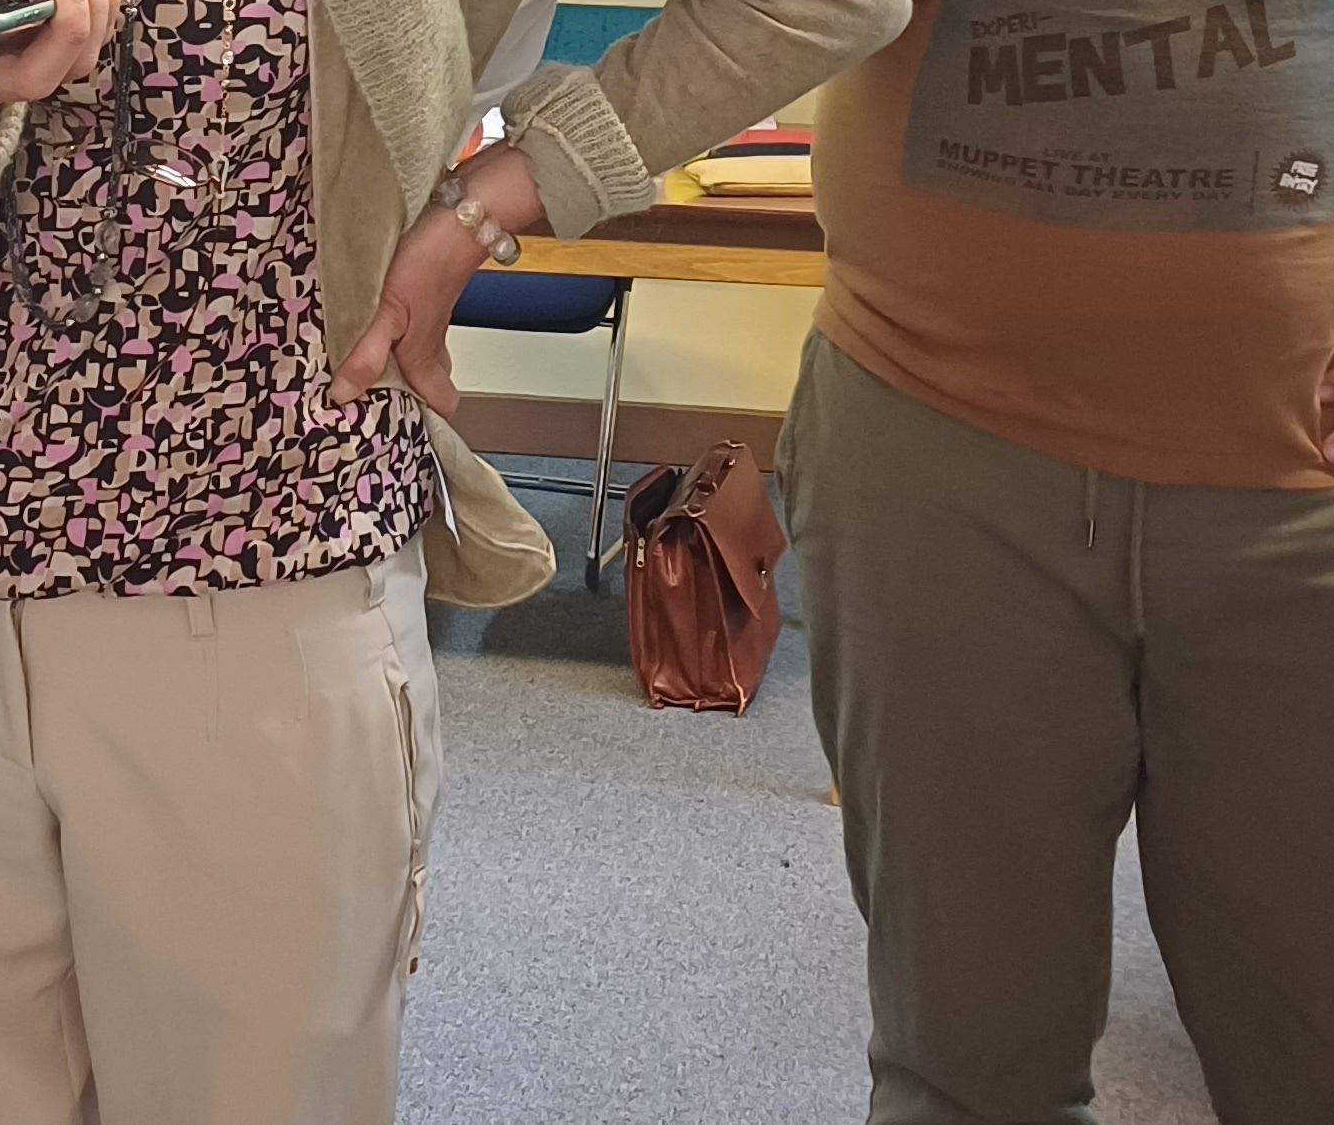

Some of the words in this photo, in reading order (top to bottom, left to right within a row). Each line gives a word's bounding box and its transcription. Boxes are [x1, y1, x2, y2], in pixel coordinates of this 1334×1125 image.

[970, 11, 1053, 39] EXPERI-
[939, 138, 1061, 180] MUPPET
[1070, 164, 1236, 189] THEATRE
[1042, 147, 1084, 162] LIVE
[1088, 151, 1111, 163] AT
[936, 158, 1017, 186] SHOWING
[1021, 179, 1056, 194] ALL
[1064, 186, 1106, 199] DAY
[1111, 189, 1183, 201] EVERY
[1192, 190, 1233, 201] DAY
